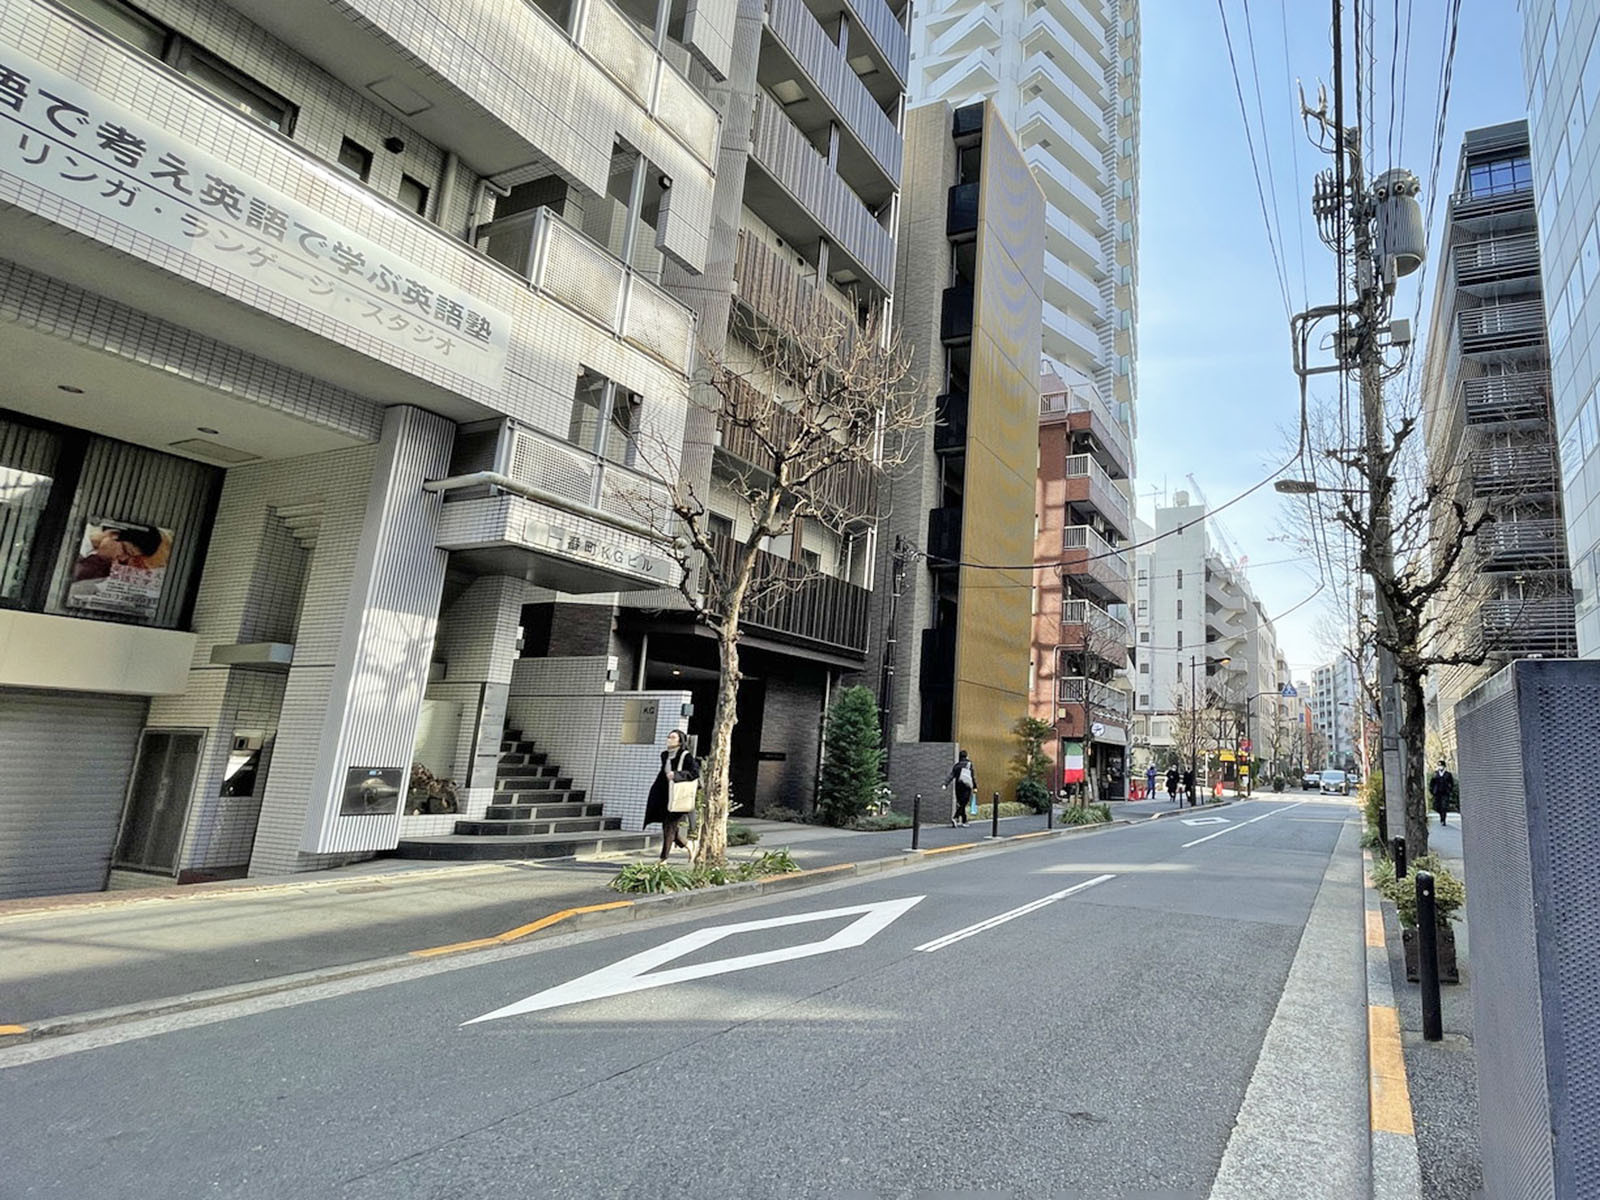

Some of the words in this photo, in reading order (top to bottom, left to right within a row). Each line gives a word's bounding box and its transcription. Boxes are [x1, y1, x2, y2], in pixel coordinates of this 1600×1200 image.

[0, 64, 492, 344] 語で考え英語で学ぶ英語塾
